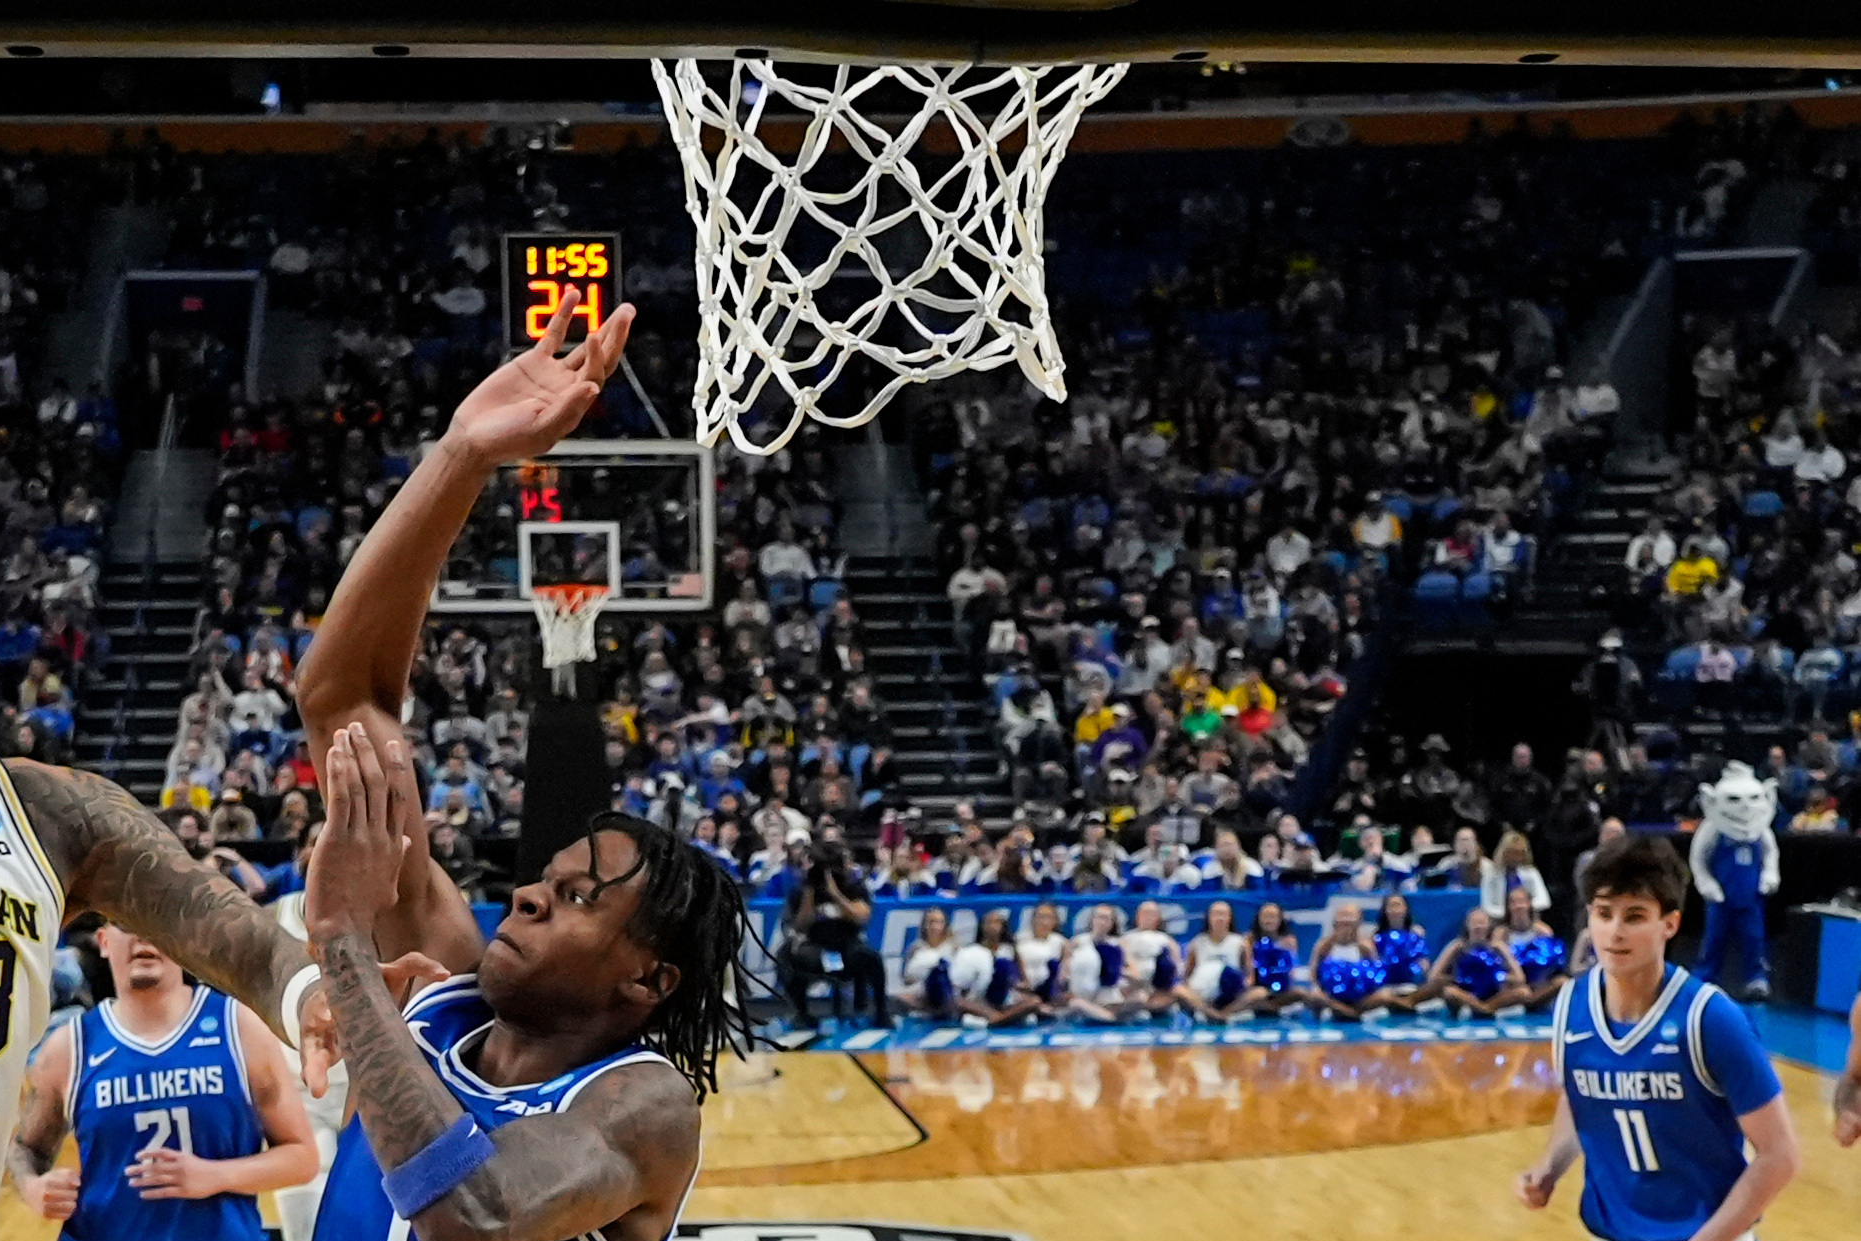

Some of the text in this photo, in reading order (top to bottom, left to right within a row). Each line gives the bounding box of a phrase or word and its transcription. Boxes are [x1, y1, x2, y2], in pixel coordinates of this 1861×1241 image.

[526, 243, 608, 278] 11:55
[525, 280, 601, 339] 24
[96, 1065, 223, 1109] BILLIKENS
[1572, 1069, 1684, 1100] BILLIKENS
[134, 1106, 194, 1168] 21
[1613, 1108, 1660, 1172] 11
